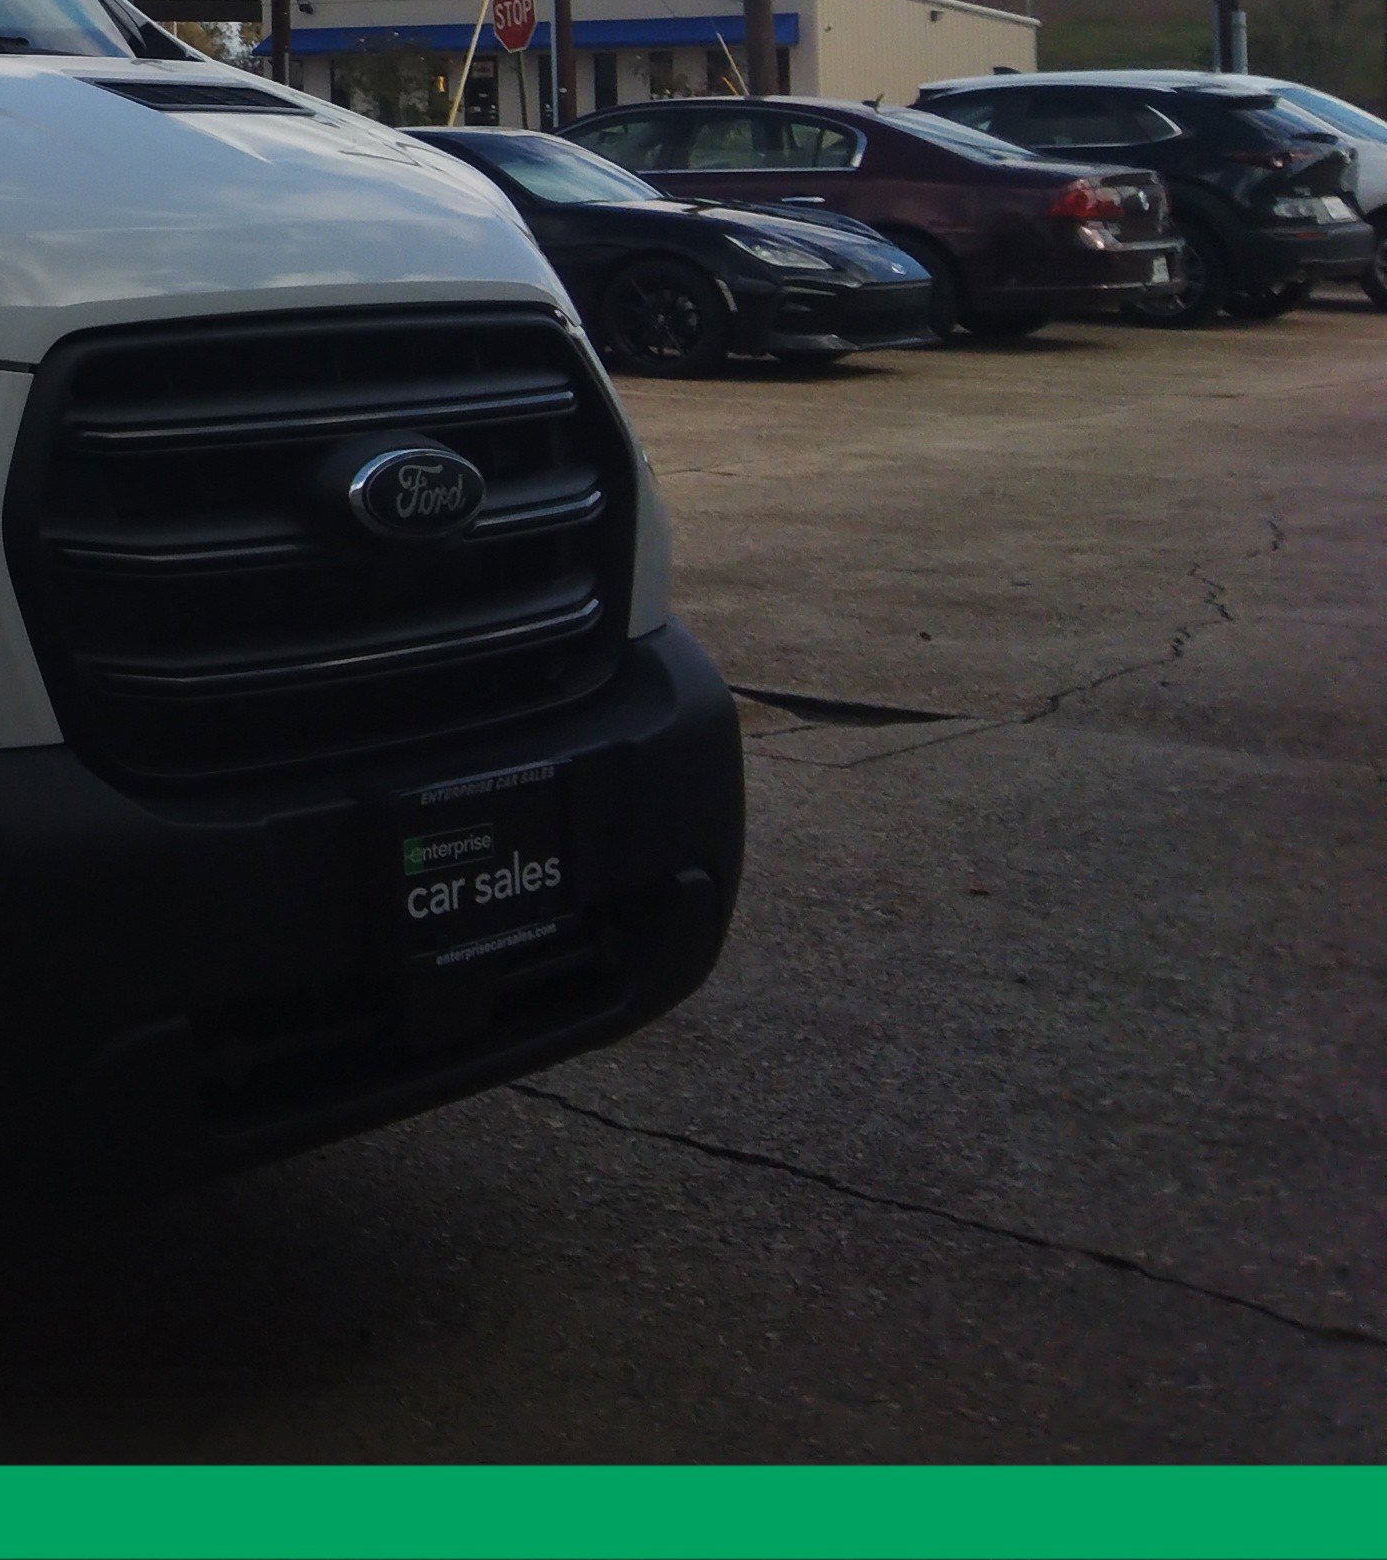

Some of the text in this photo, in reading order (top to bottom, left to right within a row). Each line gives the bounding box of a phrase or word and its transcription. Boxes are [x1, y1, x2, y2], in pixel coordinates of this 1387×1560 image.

[396, 464, 466, 518] Ford
[420, 767, 555, 805] ENTERPRISE CAR SALES
[409, 833, 492, 864] enterprise
[407, 850, 562, 919] car sales
[435, 922, 558, 967] enterprisecarsales.com
